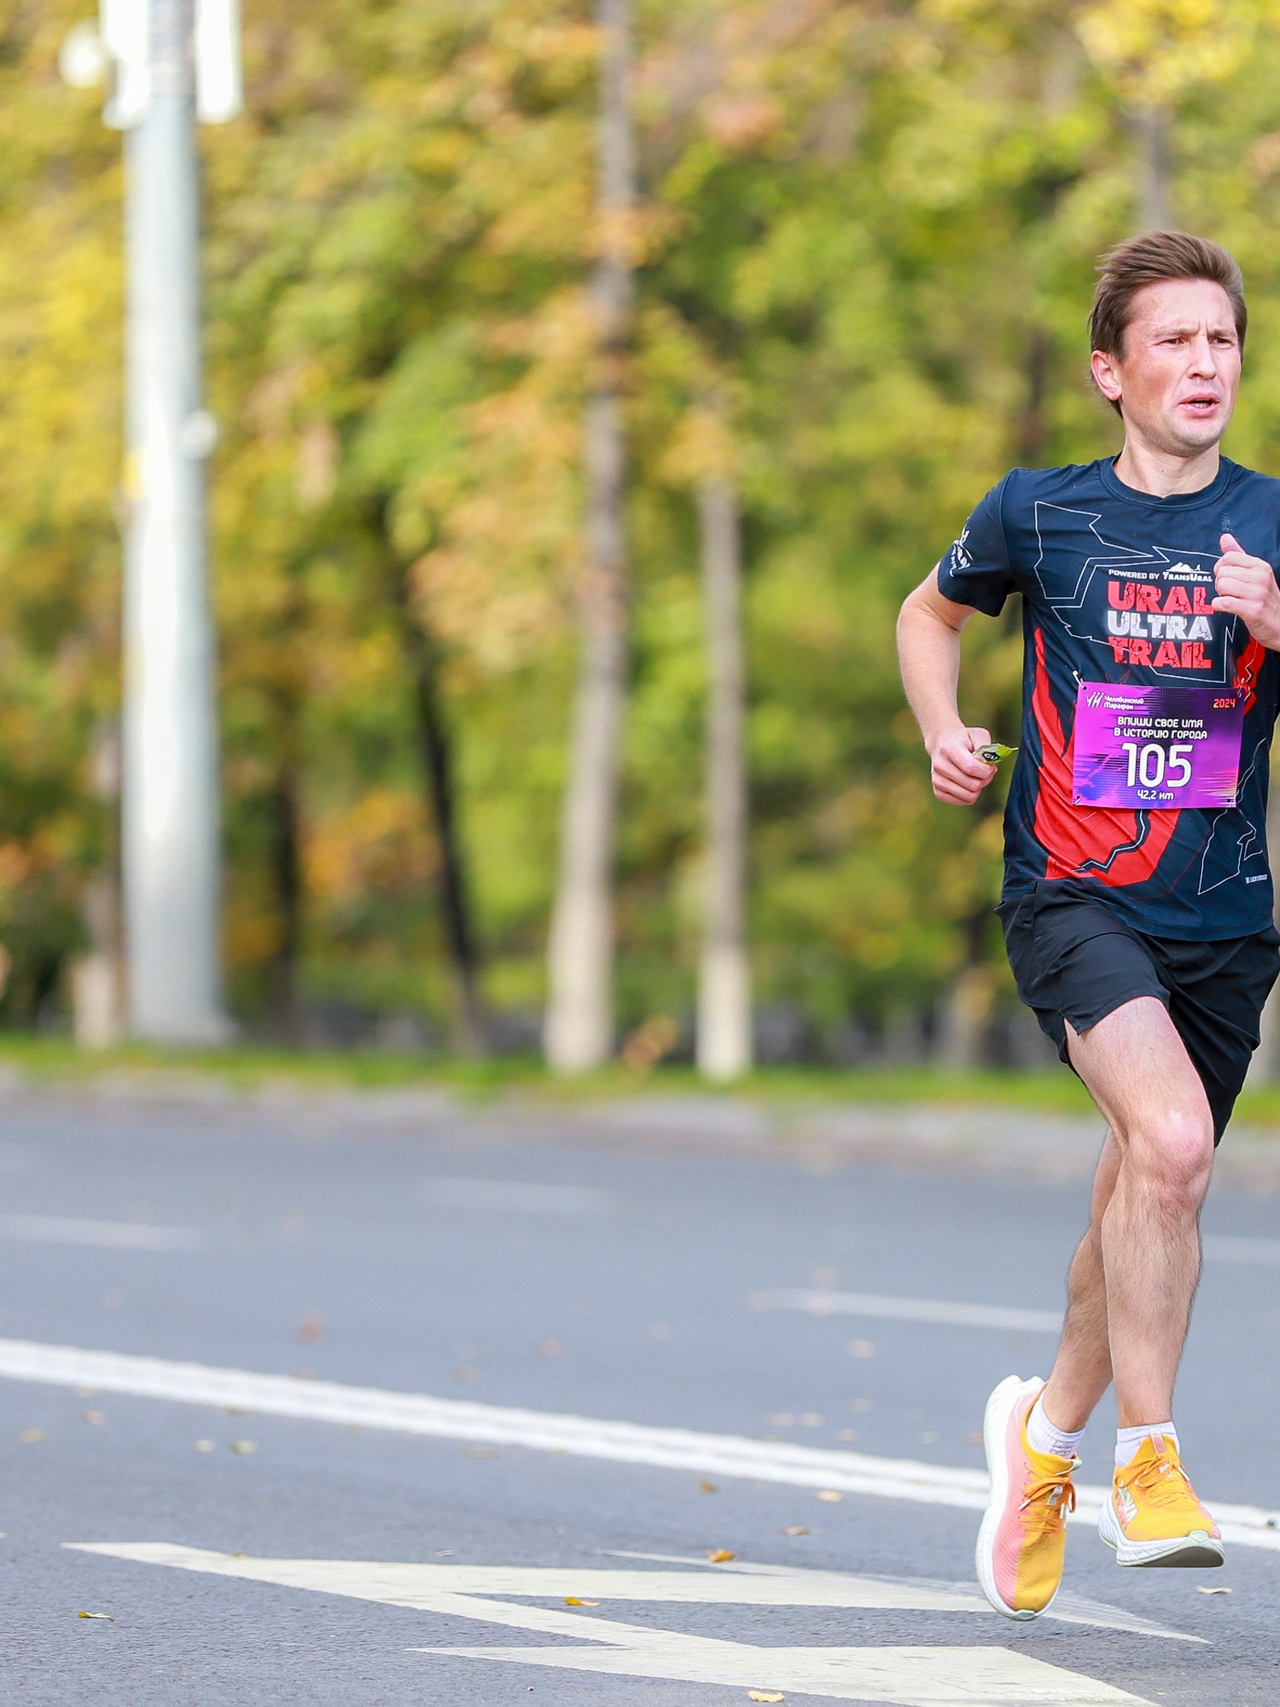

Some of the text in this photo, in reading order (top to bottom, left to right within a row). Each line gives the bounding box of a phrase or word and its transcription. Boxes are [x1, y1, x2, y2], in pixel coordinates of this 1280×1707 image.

[1108, 568, 1147, 580] POWERED
[1149, 572, 1160, 580] BY
[1107, 581, 1214, 614] URAL
[1107, 610, 1213, 640] ULTRA
[1107, 637, 1212, 669] TRAIL
[1213, 698, 1236, 709] 2024
[1117, 716, 1153, 727] ВПИШИ
[1154, 718, 1180, 728] СВОЕ
[1113, 727, 1208, 740] В ИСТОРИЮ ГОРОДА
[1121, 742, 1193, 788] 105
[1137, 789, 1157, 800] 42,2
